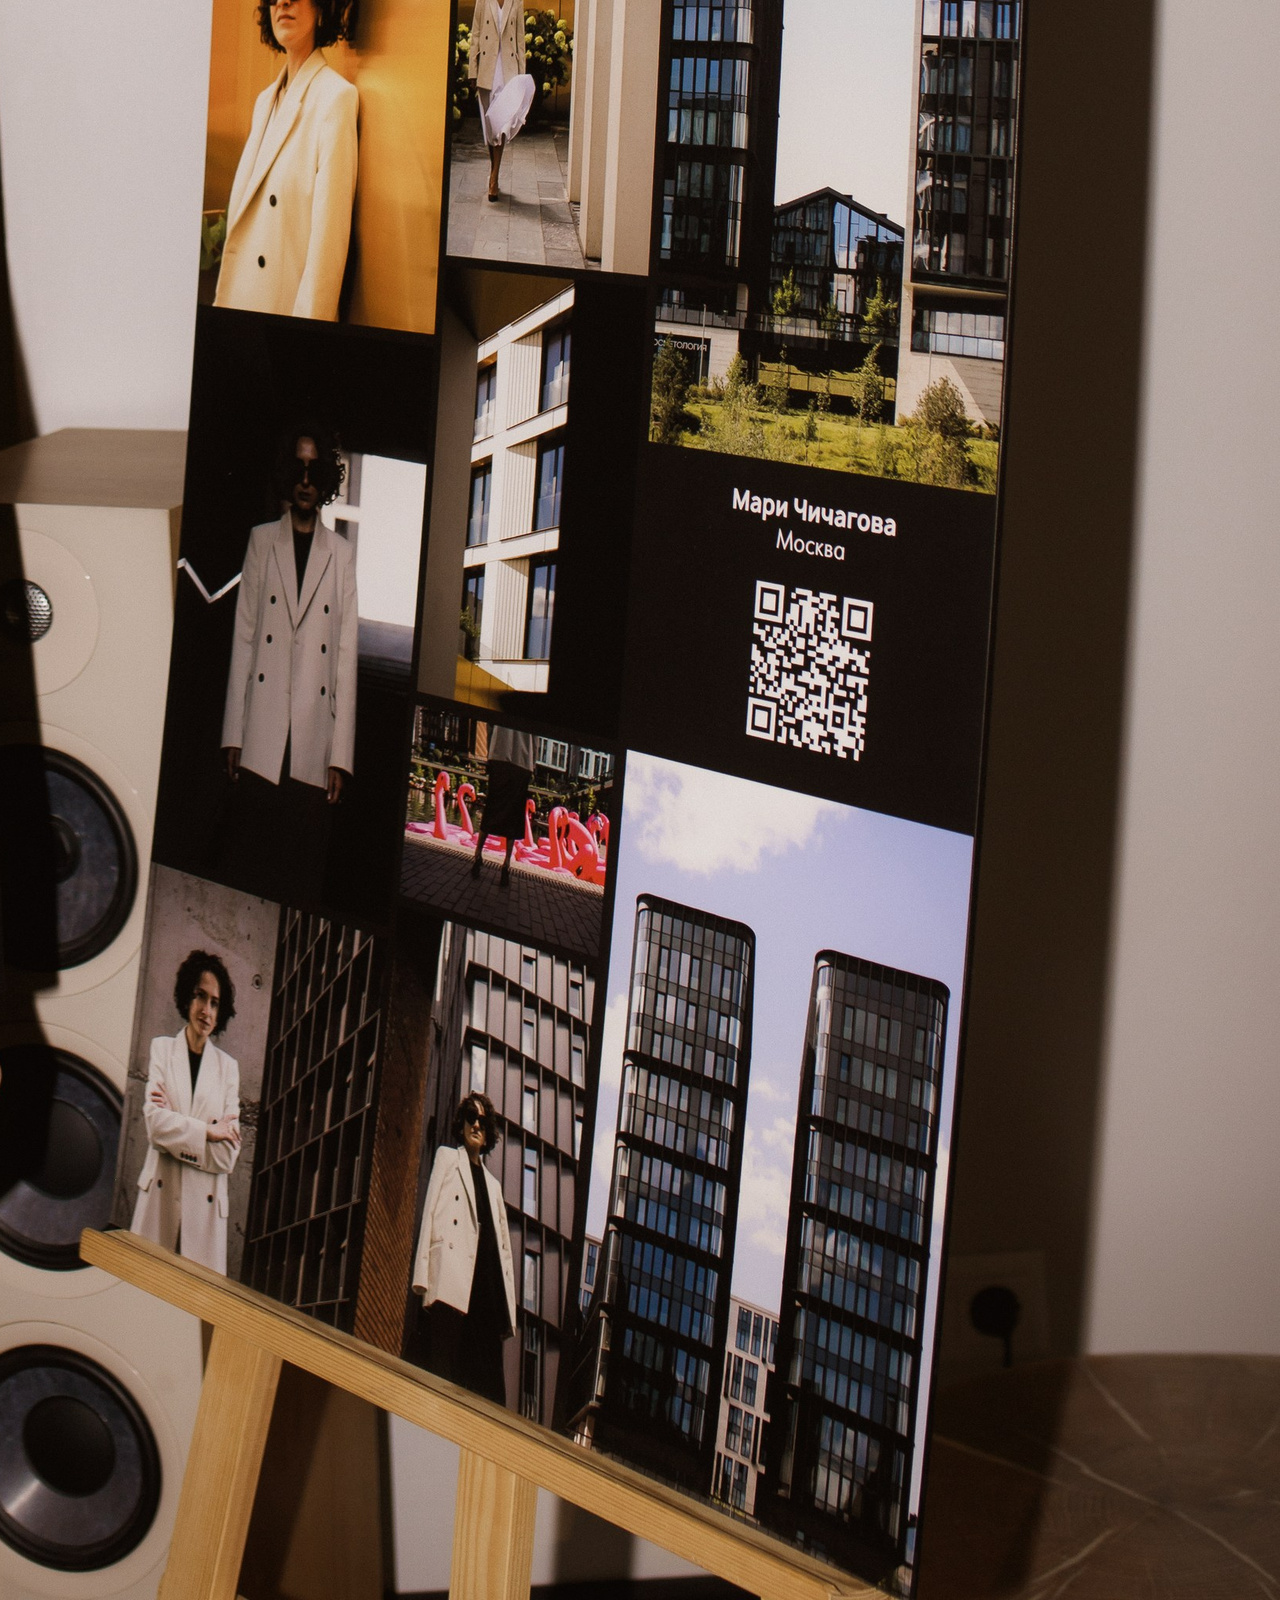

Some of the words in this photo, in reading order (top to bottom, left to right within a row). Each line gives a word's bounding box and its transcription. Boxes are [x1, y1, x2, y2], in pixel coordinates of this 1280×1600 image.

[732, 487, 788, 521] Мари
[793, 497, 897, 537] Чичагова
[776, 528, 845, 561] Москва
